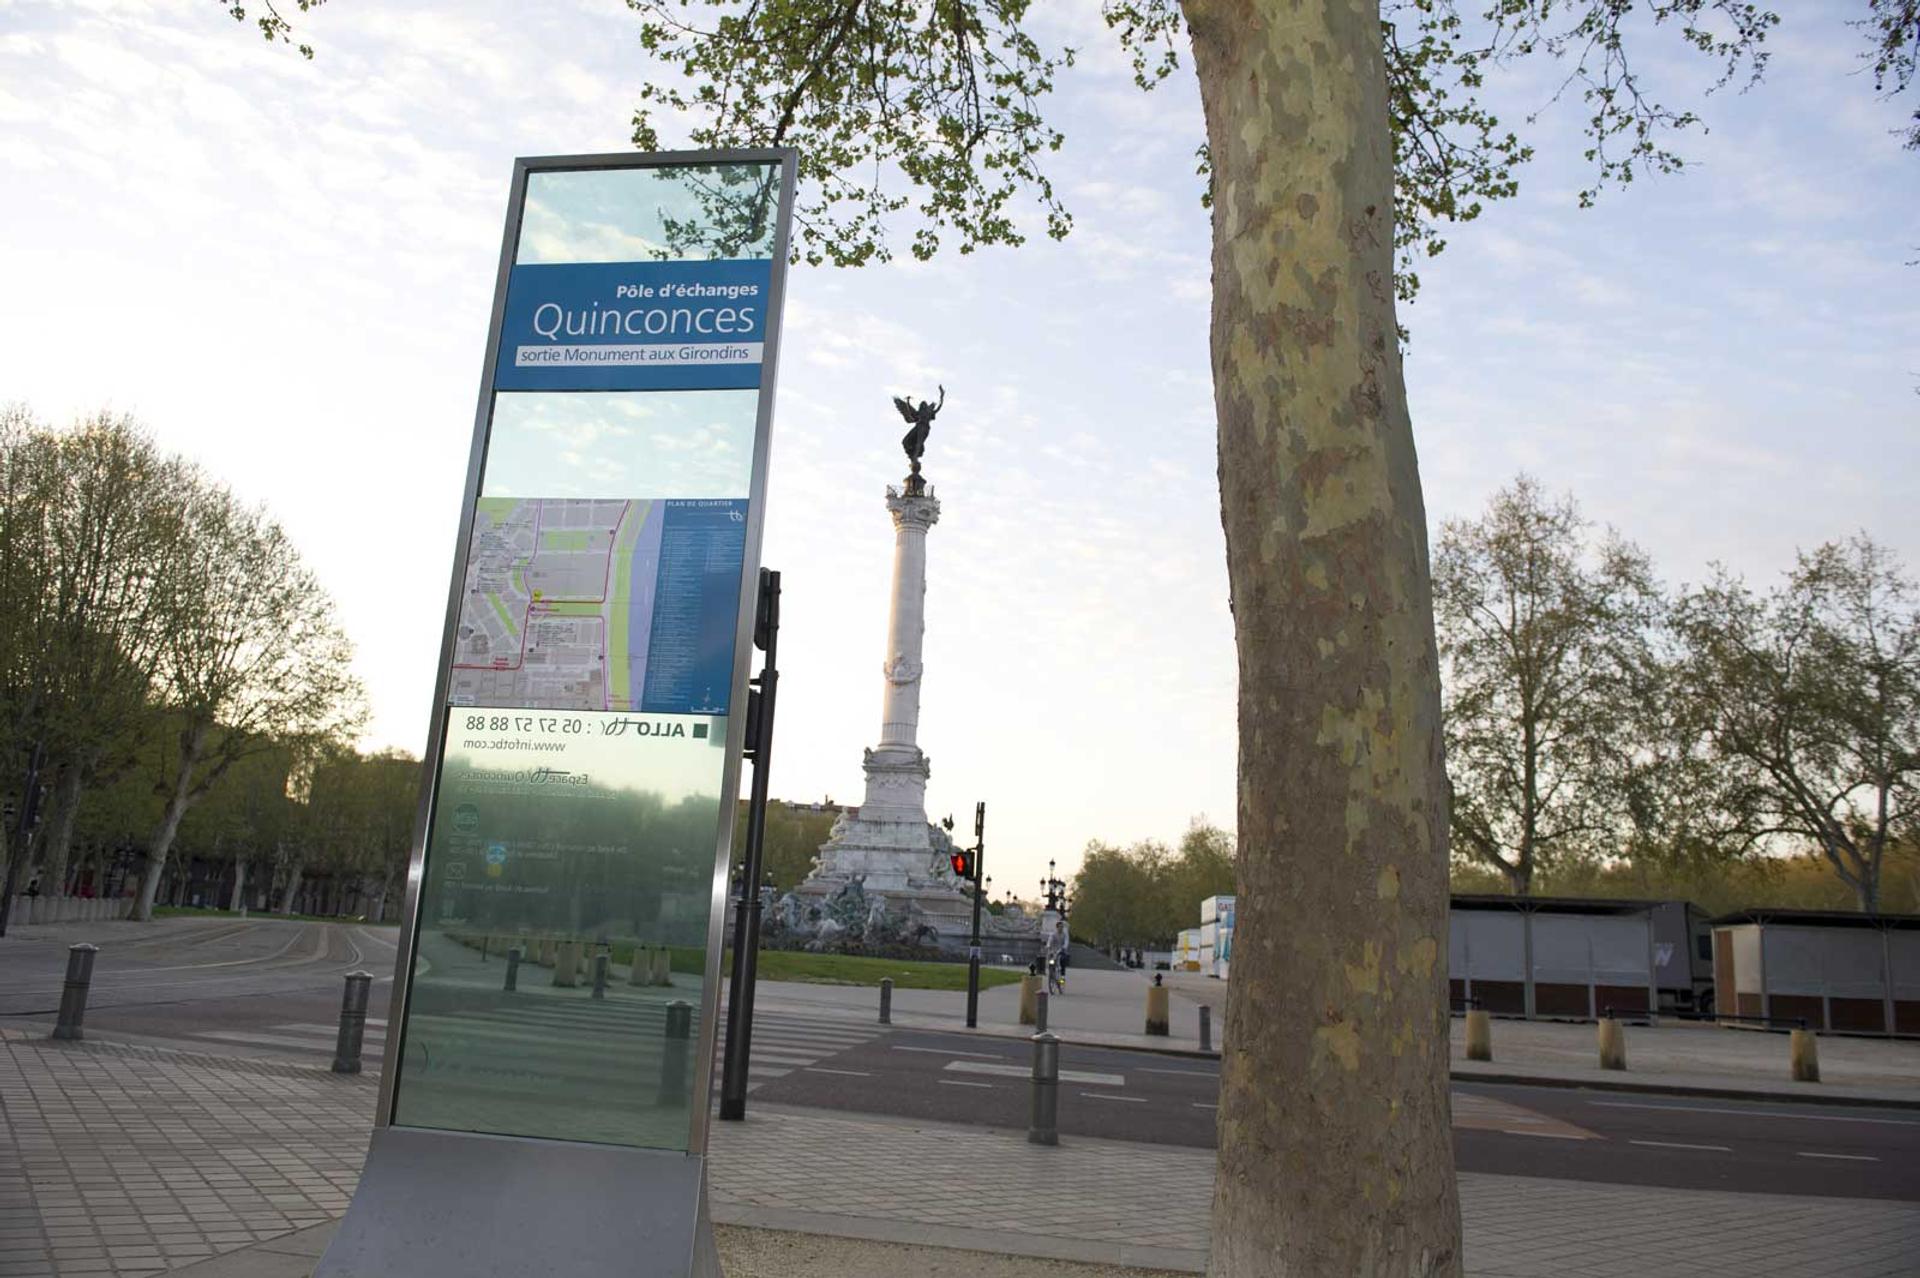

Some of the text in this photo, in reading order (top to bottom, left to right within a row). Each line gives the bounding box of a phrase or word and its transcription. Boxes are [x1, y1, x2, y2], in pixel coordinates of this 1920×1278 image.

[617, 284, 654, 298] Pôle
[533, 301, 755, 340] Quinconces
[521, 346, 749, 362] sortie Monument aux Girondins
